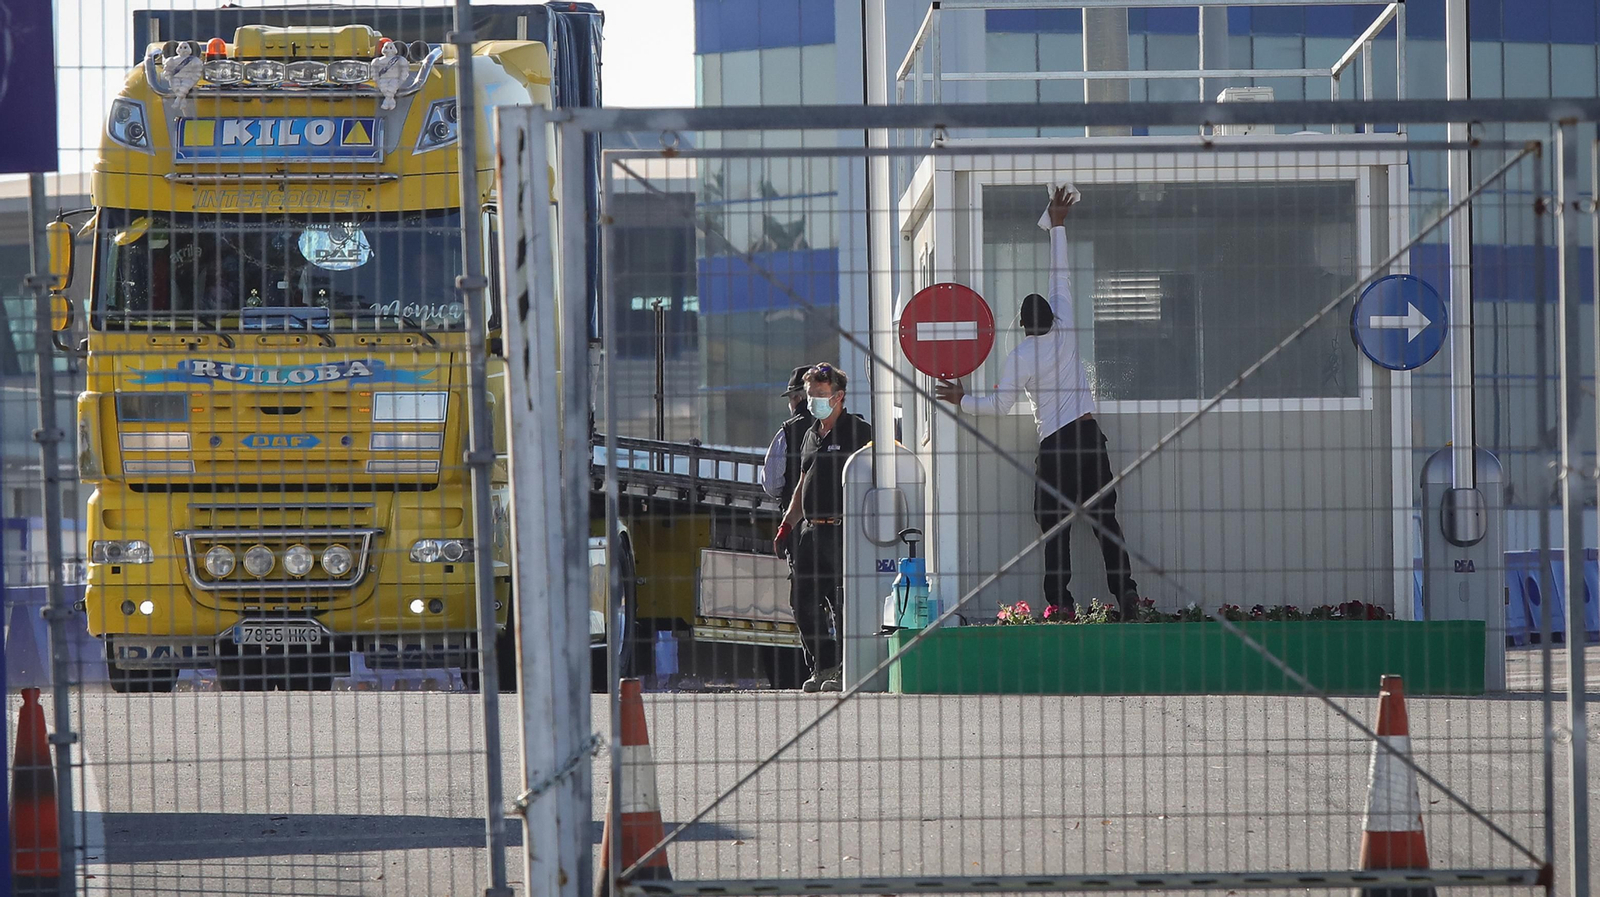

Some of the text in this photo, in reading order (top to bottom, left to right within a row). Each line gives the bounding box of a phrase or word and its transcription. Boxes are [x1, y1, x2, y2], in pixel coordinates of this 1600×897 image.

[222, 119, 335, 146] KILO
[196, 189, 368, 208] INTERCOOLER
[315, 249, 362, 260] DAF
[369, 299, 463, 324] Mónica
[191, 360, 374, 384] RUILOBA
[252, 436, 311, 447] DAF
[245, 628, 319, 643] 7855 HKG
